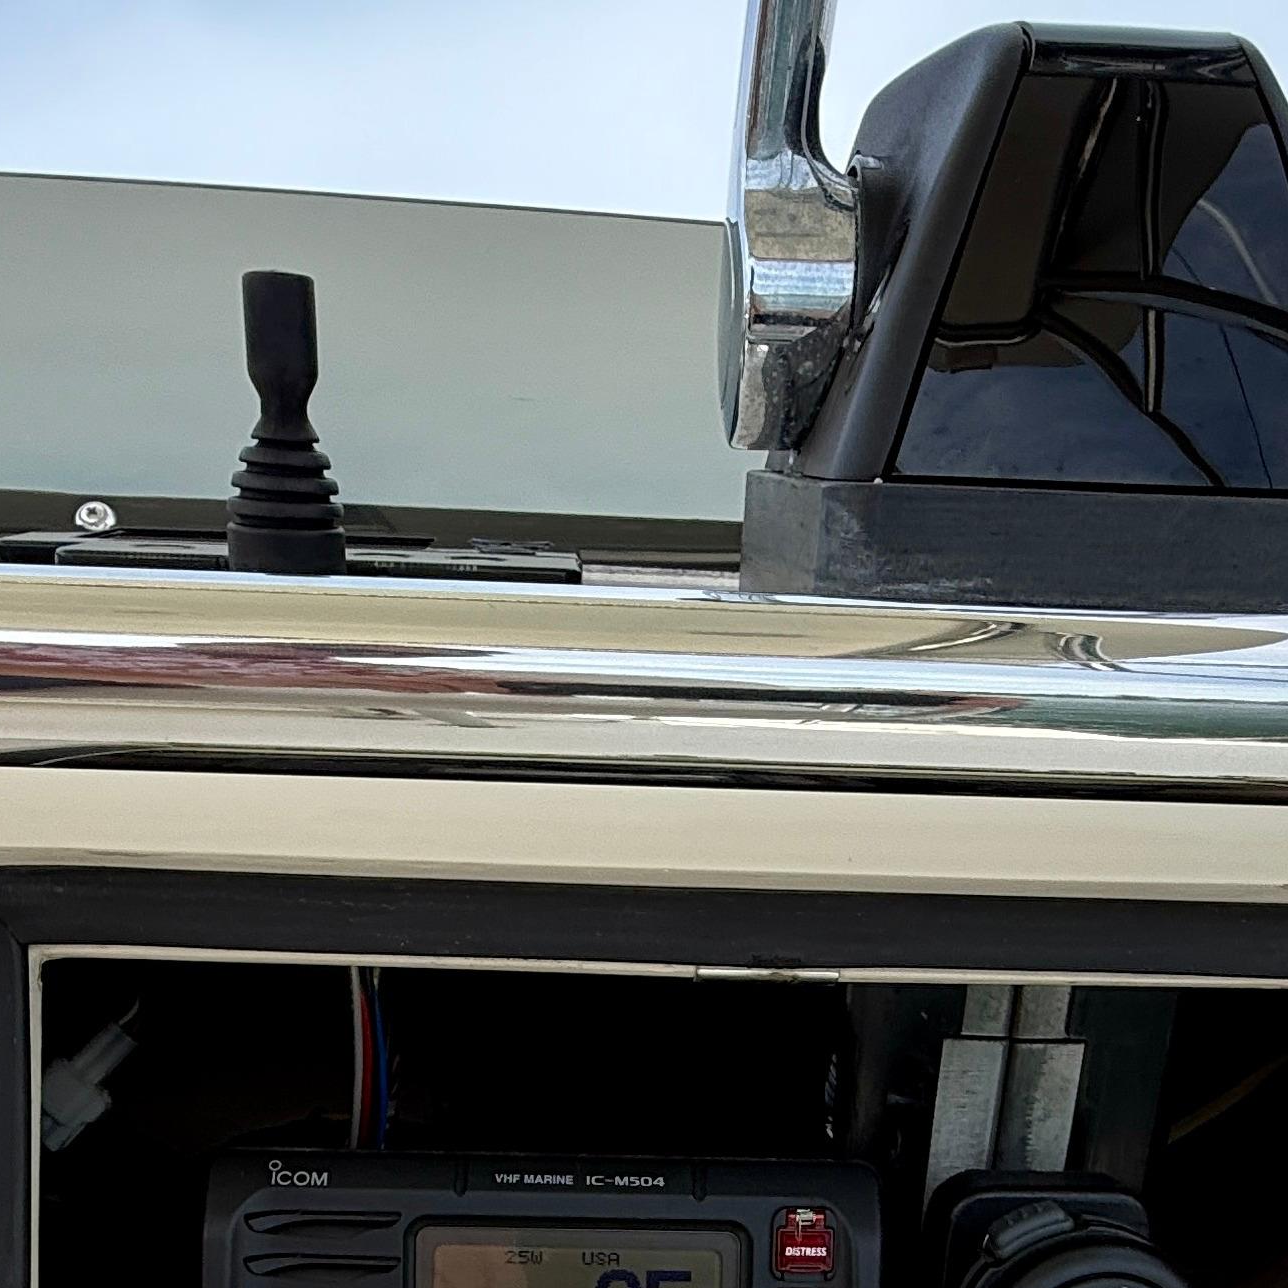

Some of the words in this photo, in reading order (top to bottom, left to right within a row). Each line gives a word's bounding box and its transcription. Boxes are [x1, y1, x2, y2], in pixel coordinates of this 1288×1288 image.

[495, 1174, 521, 1185] VHF
[523, 1175, 574, 1186] MARINE
[586, 1176, 665, 1188] IC-M504
[505, 1251, 544, 1265] 25W
[582, 1251, 620, 1266] USA
[785, 1246, 827, 1258] DISTRESS
